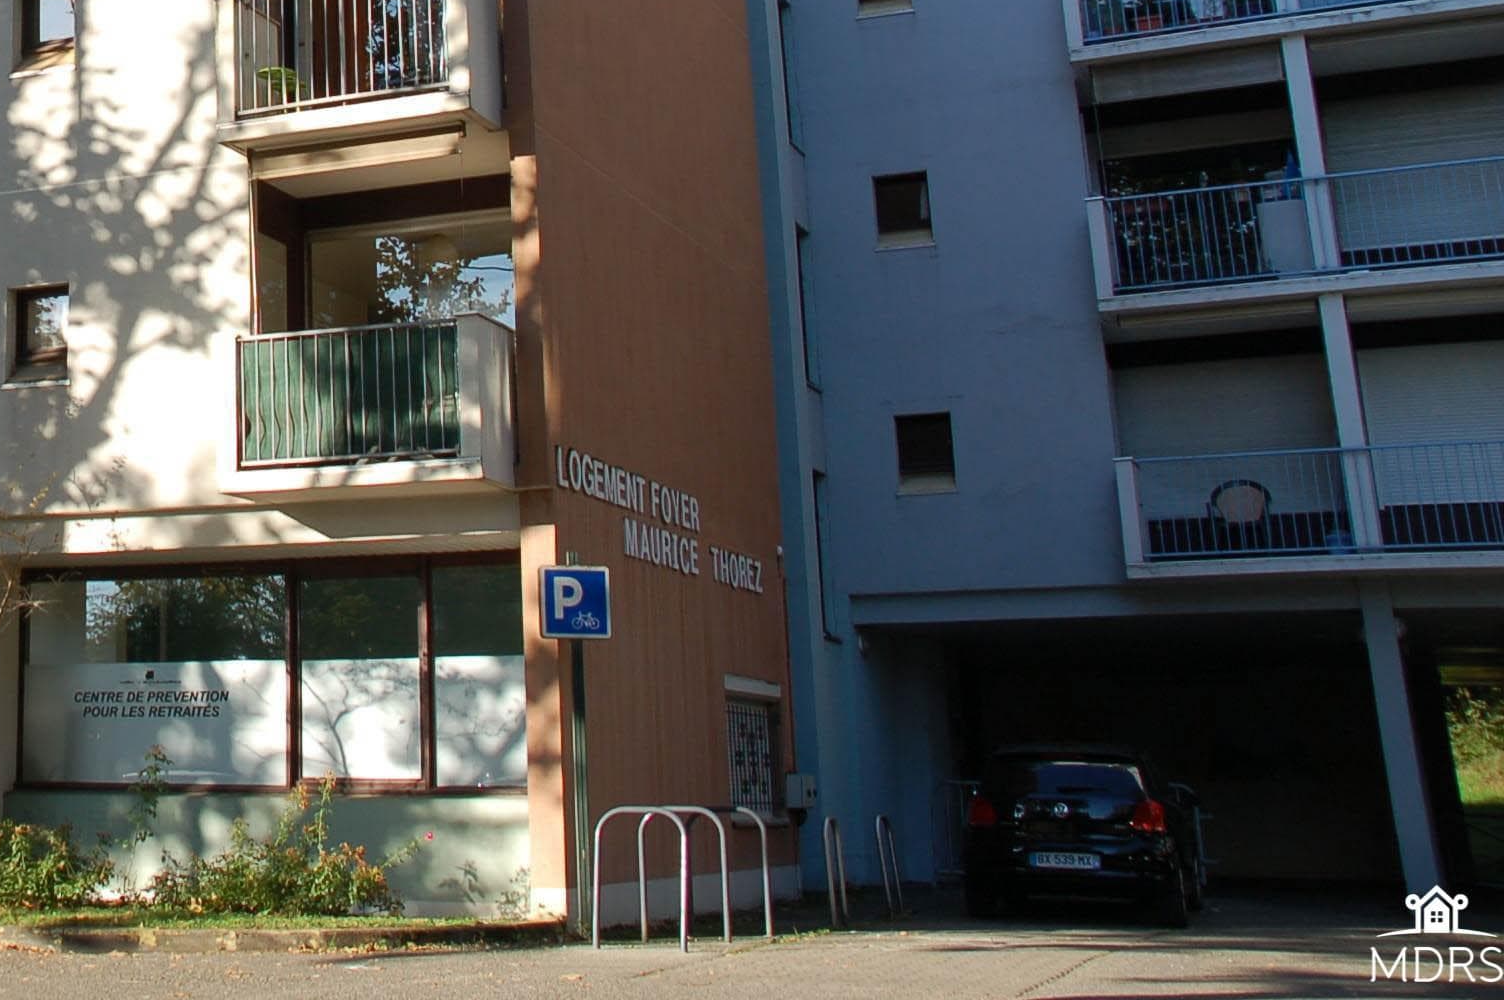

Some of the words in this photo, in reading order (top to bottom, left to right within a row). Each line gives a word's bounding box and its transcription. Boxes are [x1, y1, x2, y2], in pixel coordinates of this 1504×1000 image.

[556, 445, 646, 513] LOGEMENT
[650, 480, 701, 531] FOYER
[624, 517, 700, 576] MAURICE
[710, 545, 763, 593] THOREZ
[553, 575, 583, 619] P
[74, 690, 124, 703] CENTRE
[126, 690, 145, 703] DE
[147, 690, 229, 703] PREVENTION
[83, 705, 119, 718] POUR
[121, 705, 145, 718] LES
[148, 703, 220, 718] RETRAITÉS
